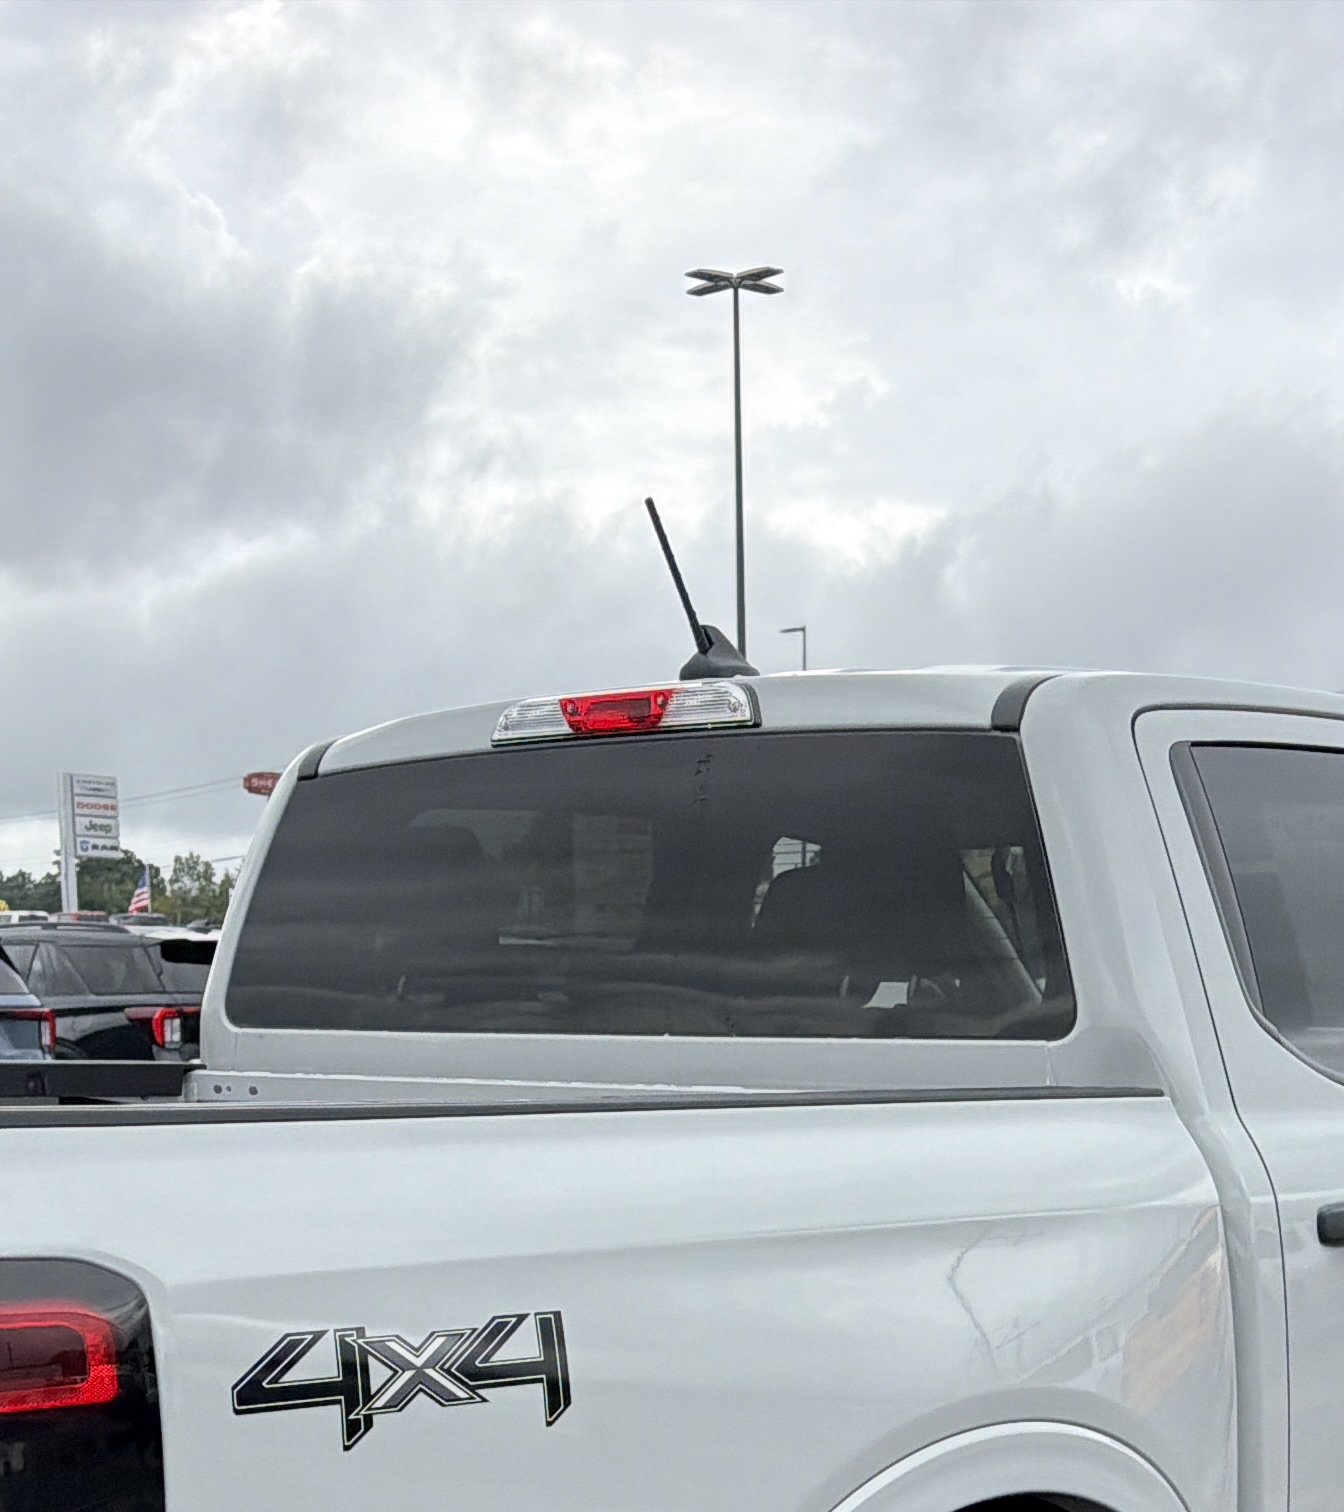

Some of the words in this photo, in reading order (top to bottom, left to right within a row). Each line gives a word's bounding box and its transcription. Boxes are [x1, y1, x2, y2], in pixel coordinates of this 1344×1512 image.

[77, 802, 118, 812] DODGE
[84, 820, 113, 834] Jeep
[91, 843, 118, 851] RAM
